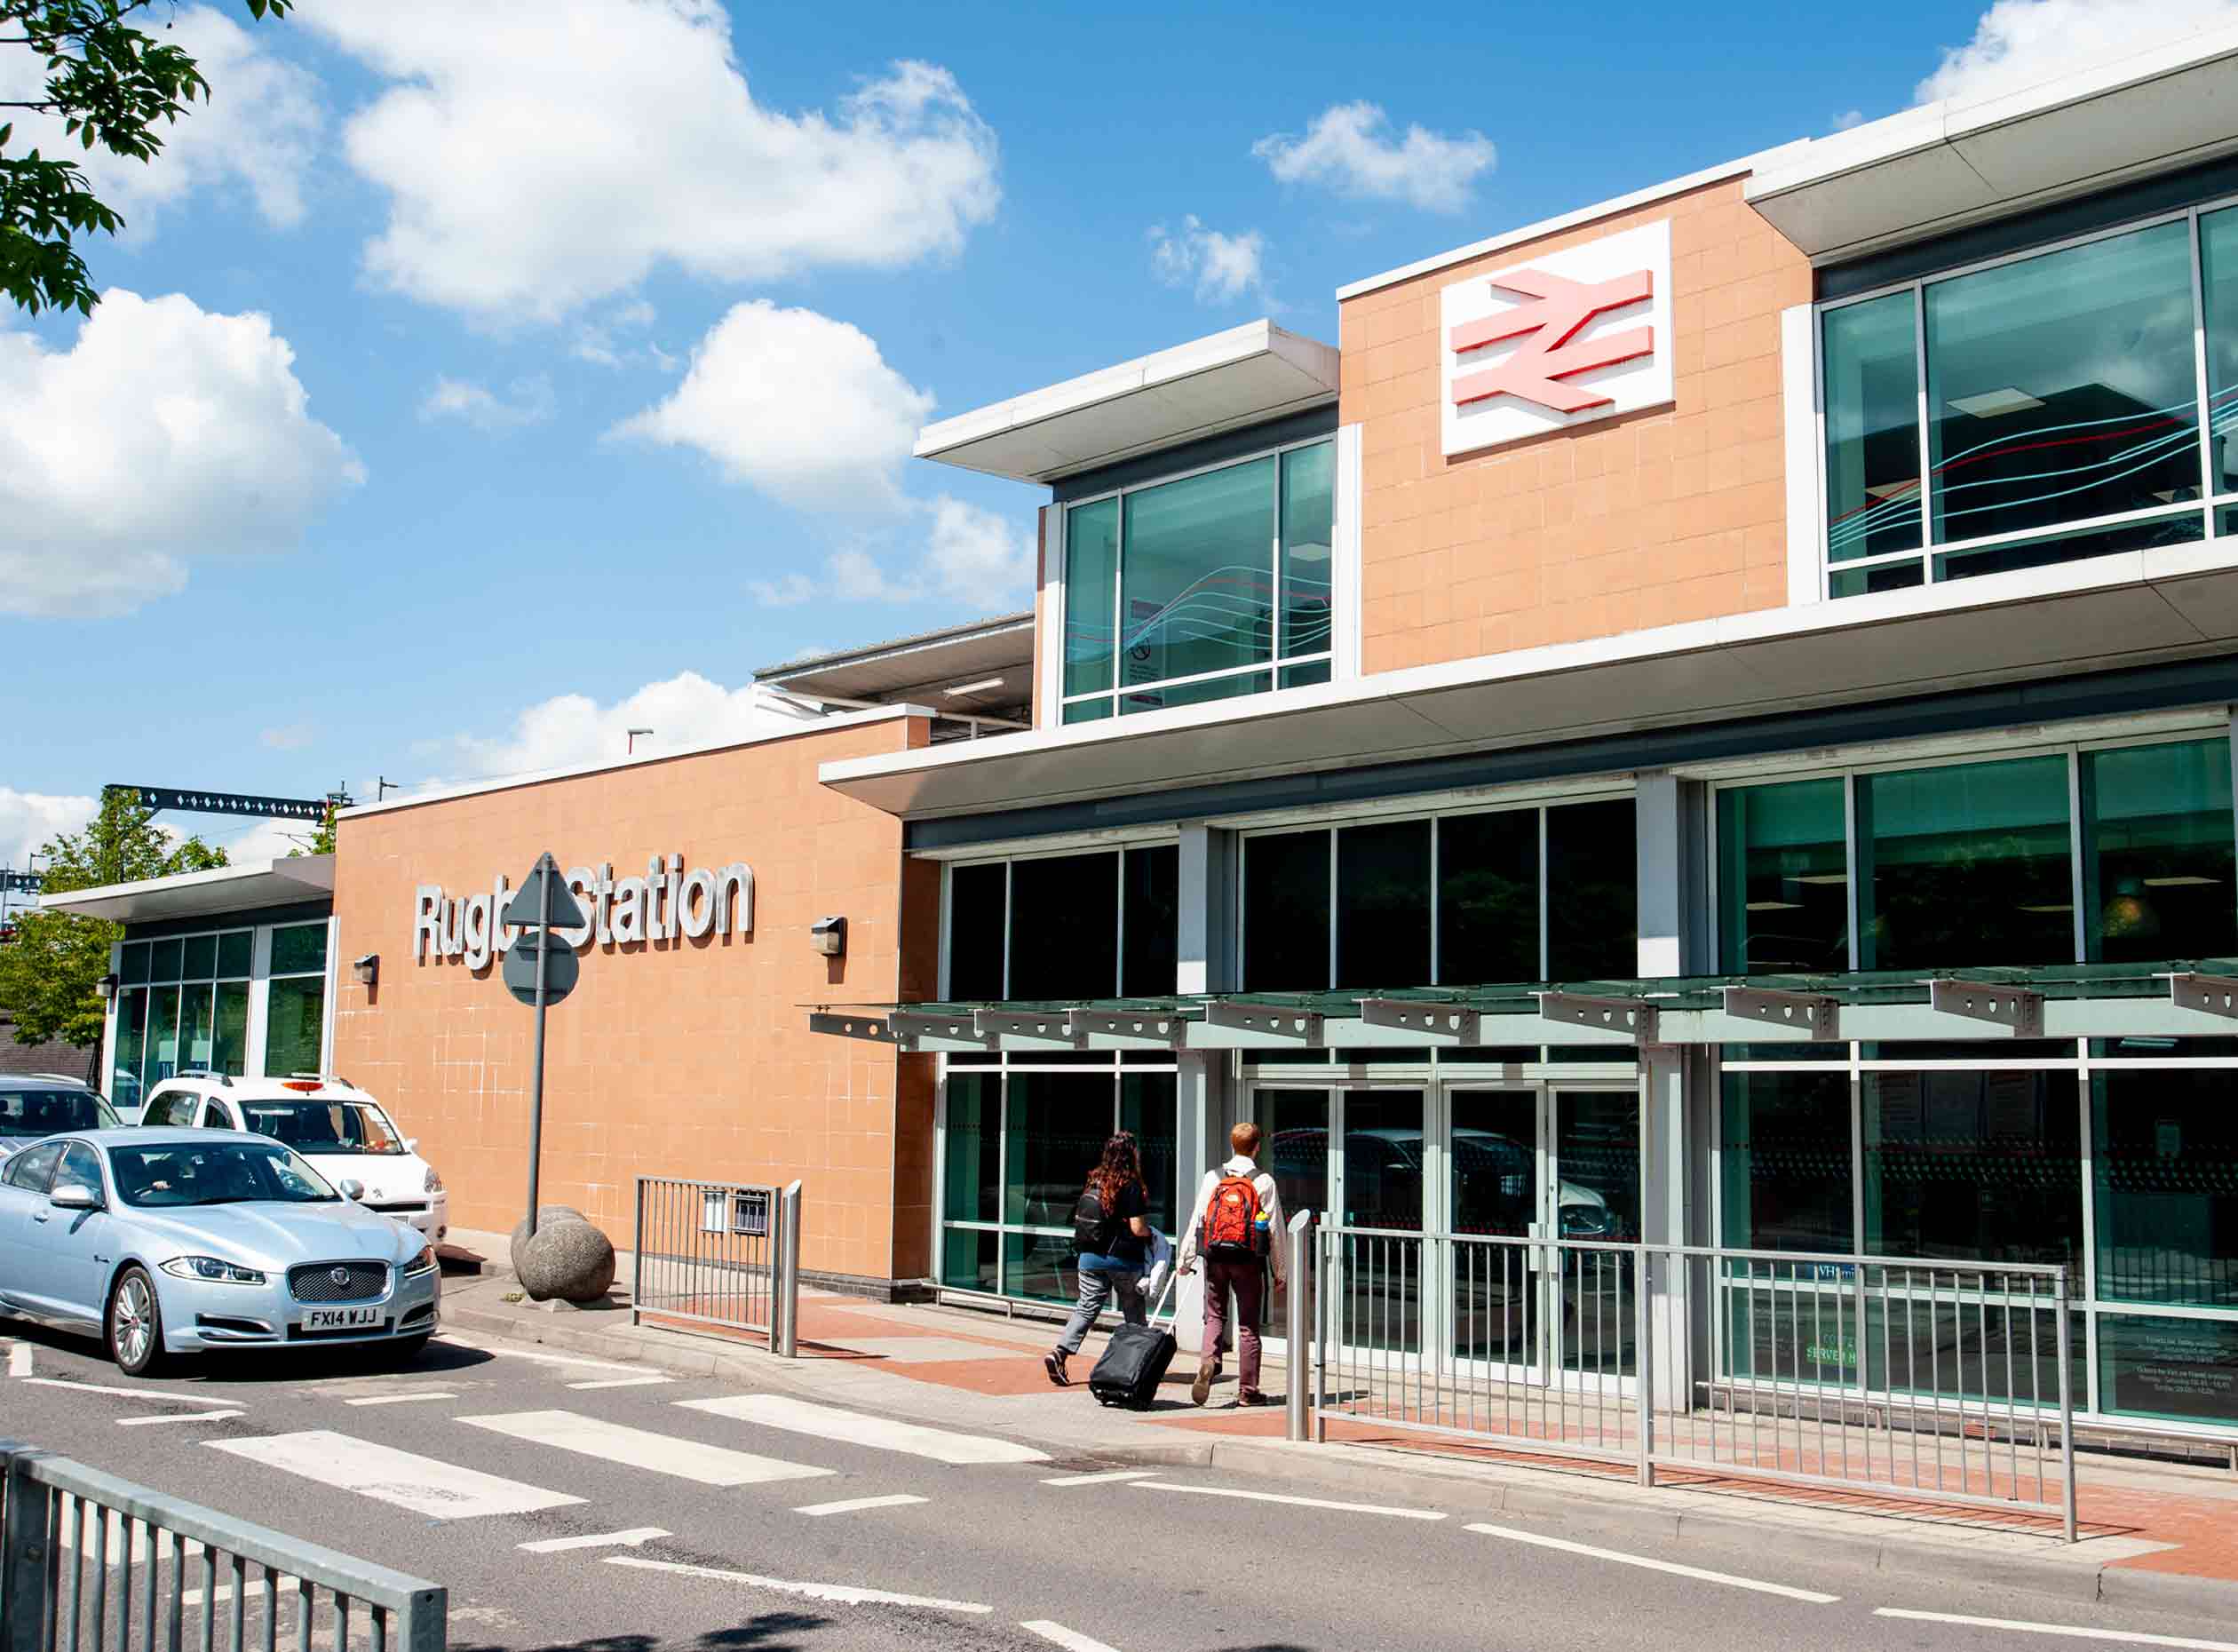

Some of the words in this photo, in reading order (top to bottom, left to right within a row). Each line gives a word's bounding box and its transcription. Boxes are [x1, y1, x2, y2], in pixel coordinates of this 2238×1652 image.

[413, 874, 538, 971] Rugb
[561, 853, 754, 948] Station
[311, 1311, 345, 1326] FX14
[349, 1308, 377, 1323] WJJ
